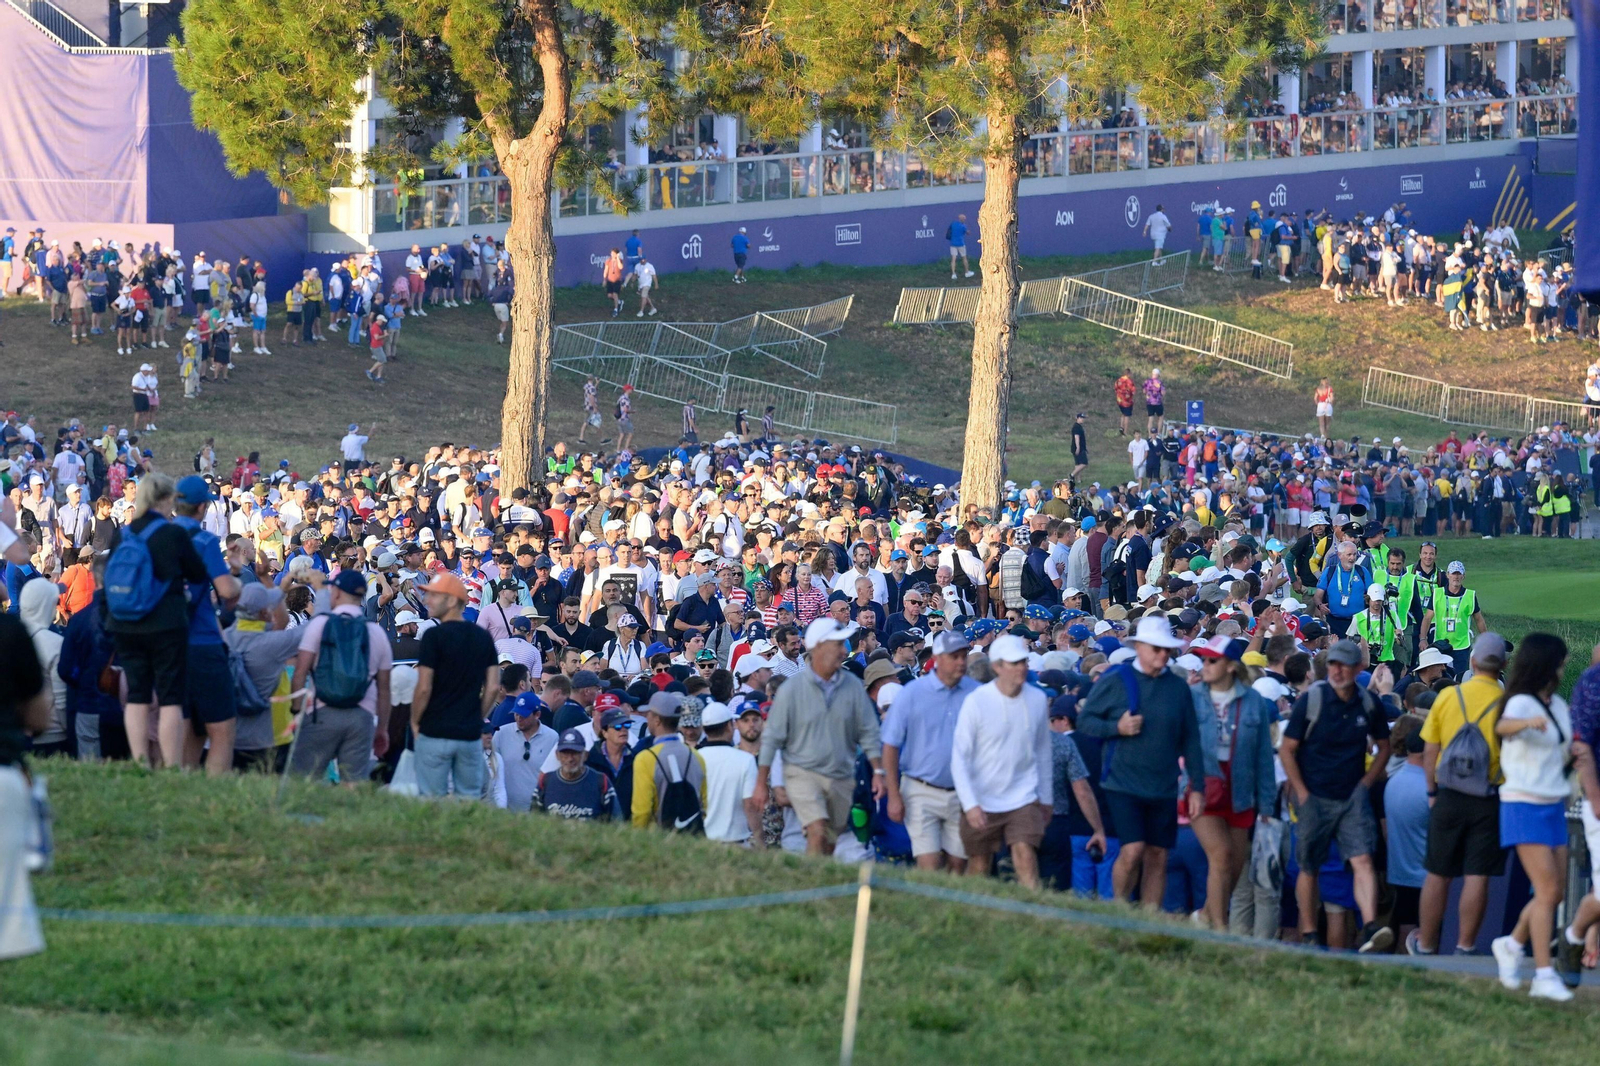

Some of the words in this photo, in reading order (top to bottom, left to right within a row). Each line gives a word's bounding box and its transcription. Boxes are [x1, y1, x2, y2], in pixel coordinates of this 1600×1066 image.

[1402, 179, 1421, 191] Hilton
[1469, 180, 1487, 189] ROLEX
[1269, 184, 1287, 207] citi
[1055, 210, 1074, 226] AON
[837, 229, 859, 242] Hilton
[915, 228, 935, 238] ROLEX
[682, 234, 702, 259] citi
